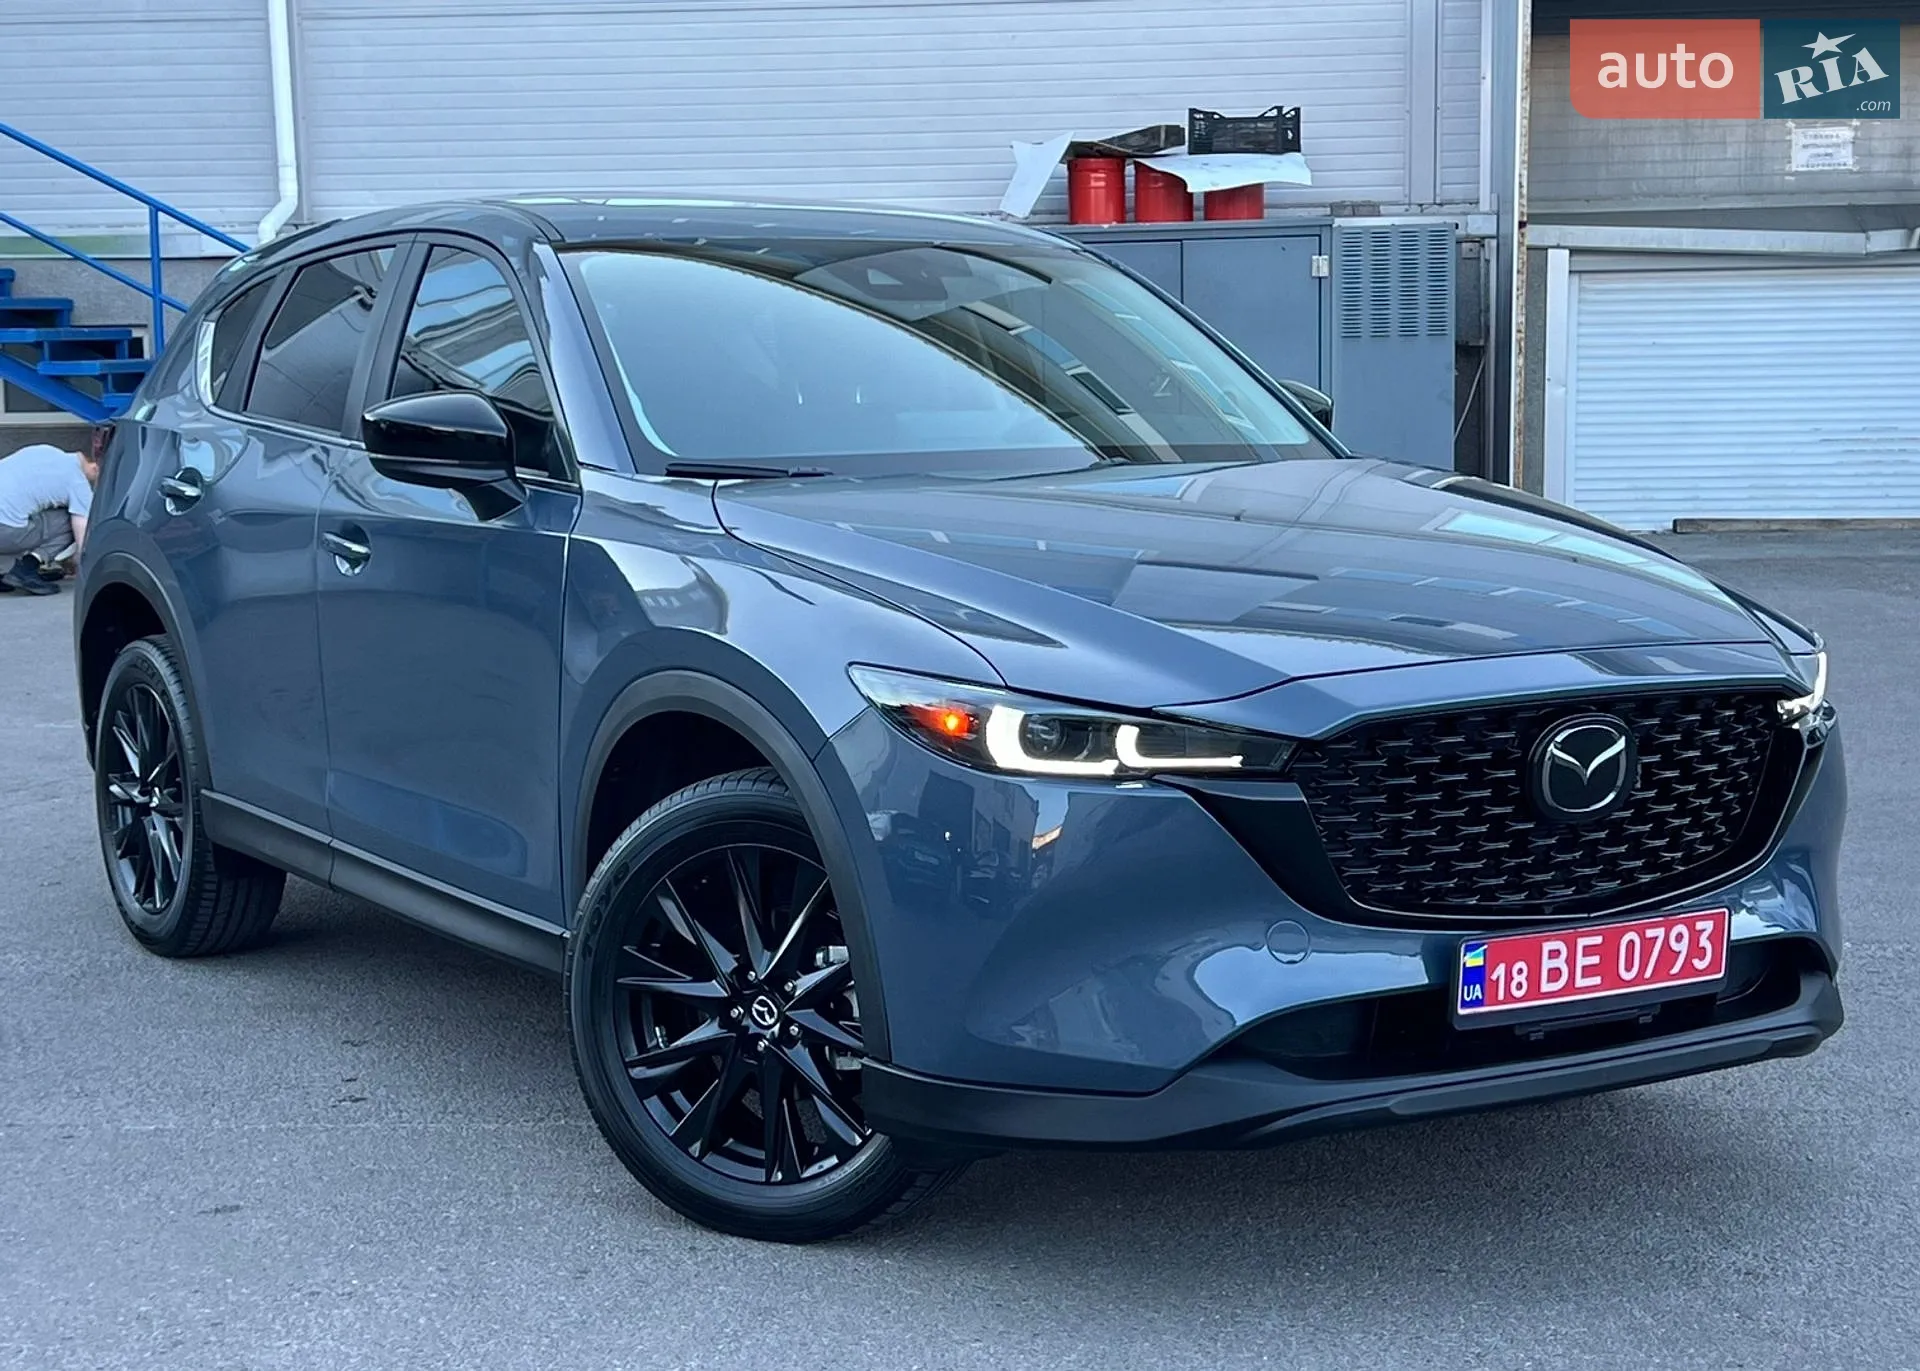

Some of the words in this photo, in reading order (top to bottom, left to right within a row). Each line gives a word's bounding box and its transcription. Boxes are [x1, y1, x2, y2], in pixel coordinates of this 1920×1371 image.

[1490, 961, 1528, 1001] 18
[1540, 935, 1603, 993] BE
[1618, 919, 1714, 982] 0793
[1463, 983, 1483, 1001] UA
